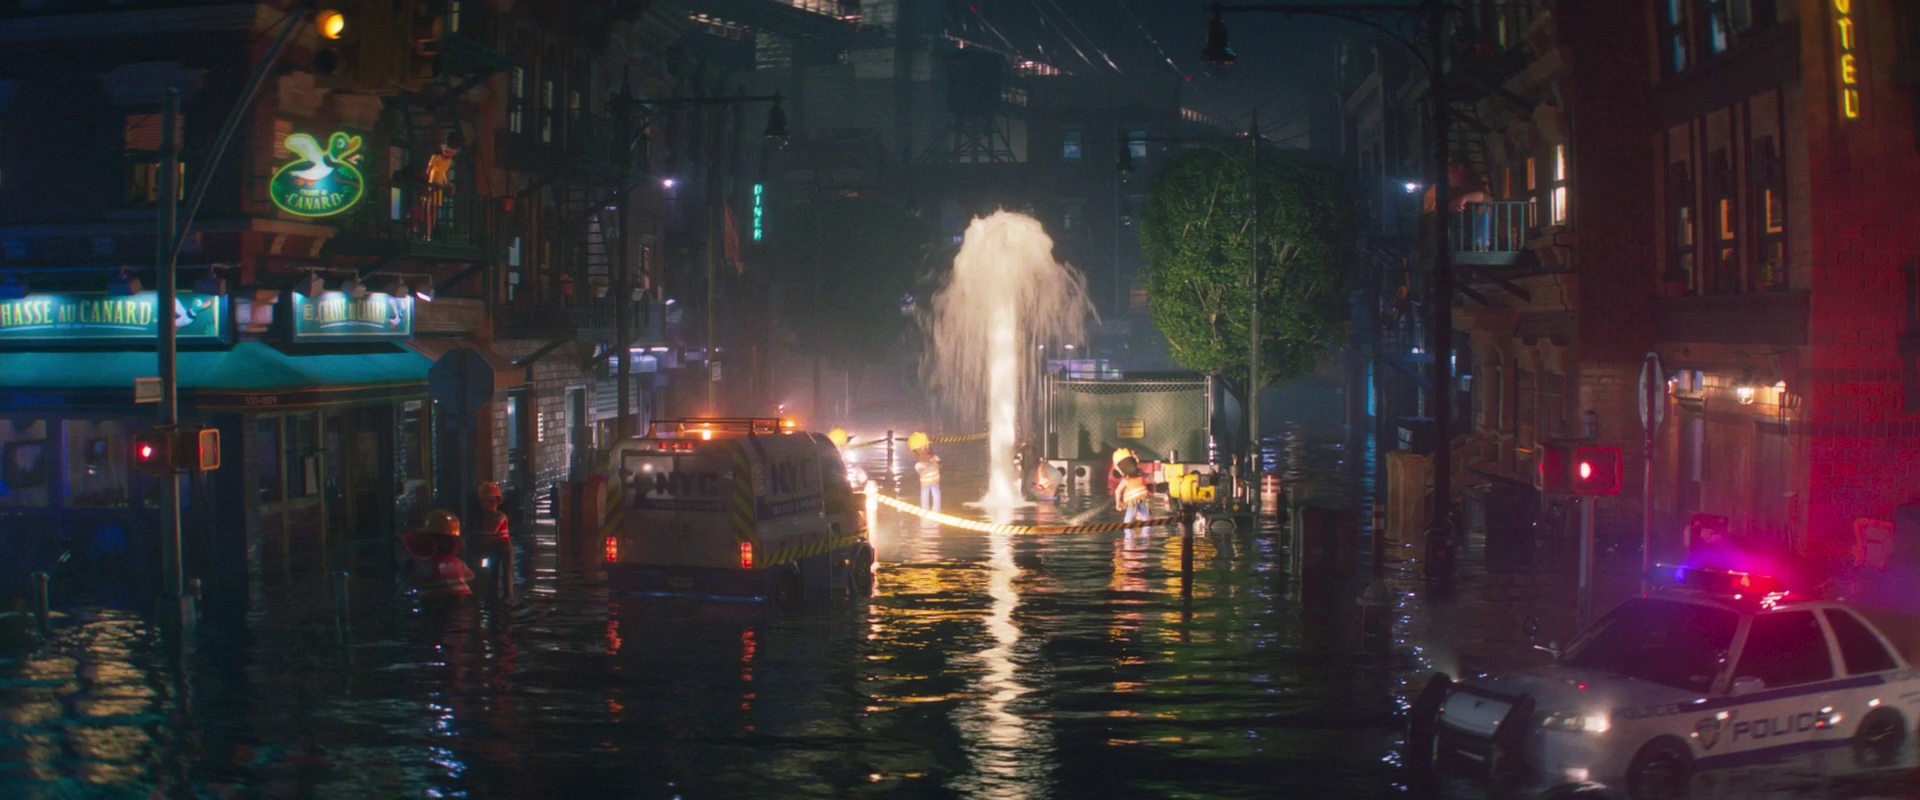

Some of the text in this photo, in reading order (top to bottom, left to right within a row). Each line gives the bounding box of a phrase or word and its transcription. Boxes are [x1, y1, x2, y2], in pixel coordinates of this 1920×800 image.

[287, 193, 342, 210] CANARD
[754, 184, 763, 240] DINER
[58, 304, 76, 322] AU
[80, 301, 151, 325] CANARD
[656, 471, 719, 496] NYC
[1732, 708, 1834, 742] POLICE
